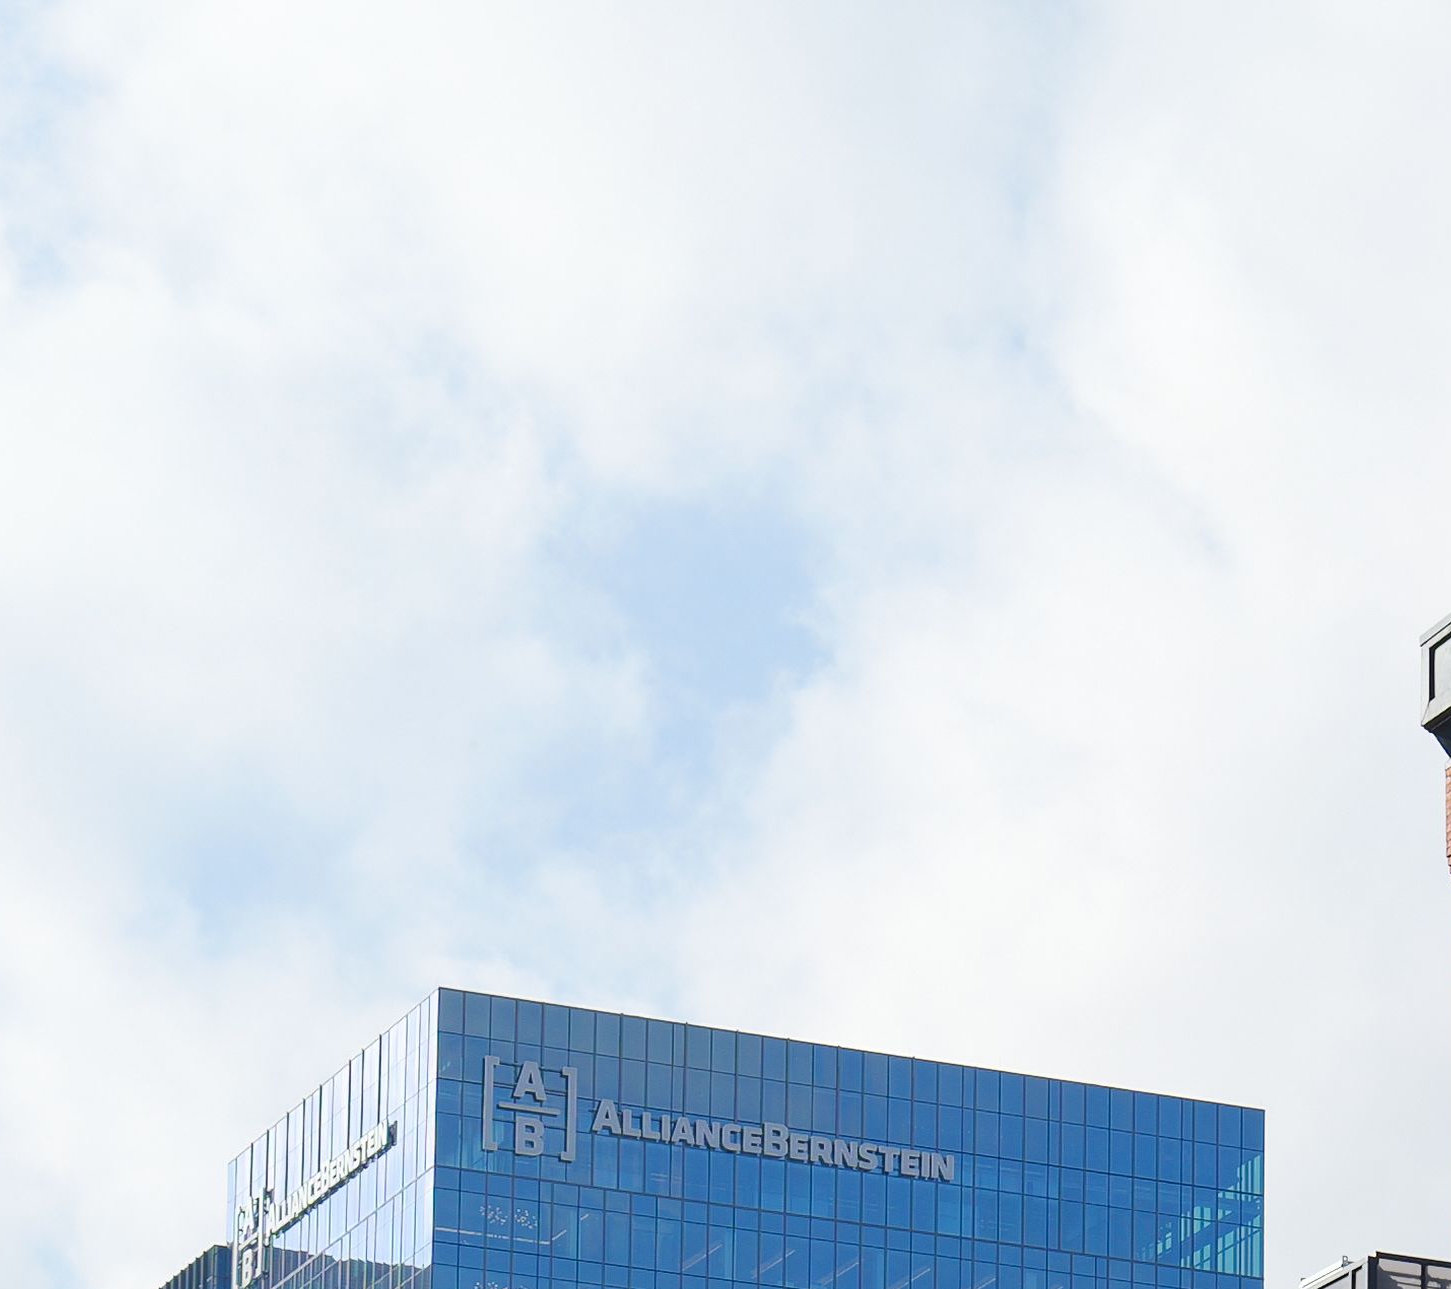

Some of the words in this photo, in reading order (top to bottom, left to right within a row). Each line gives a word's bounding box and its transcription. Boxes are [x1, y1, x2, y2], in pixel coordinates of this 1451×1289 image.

[513, 1060, 547, 1101] A
[514, 1116, 545, 1156] B
[592, 1098, 955, 1182] ALLIANCEBERNSTEIN
